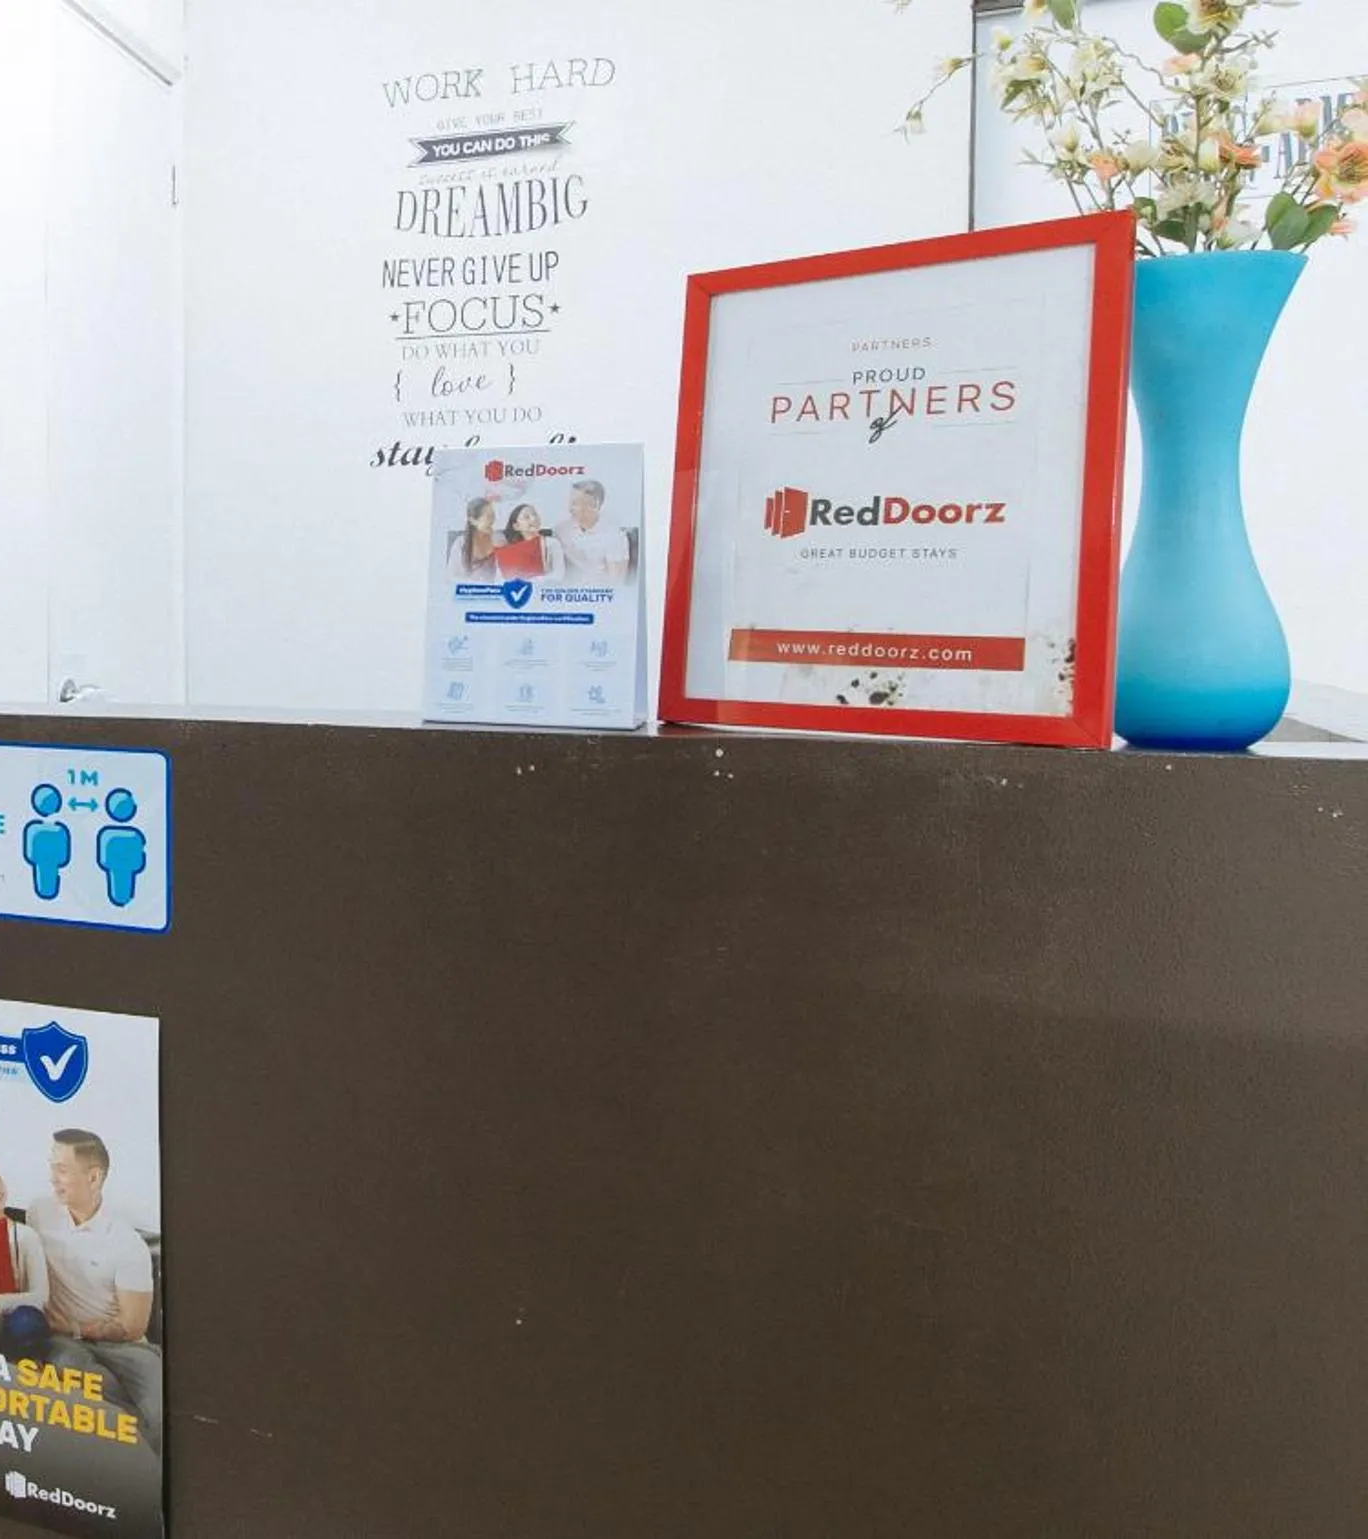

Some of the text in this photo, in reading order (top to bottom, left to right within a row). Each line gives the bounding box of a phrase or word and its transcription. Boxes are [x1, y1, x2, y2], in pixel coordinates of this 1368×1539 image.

[382, 57, 617, 108] WORK HARD
[432, 143, 460, 158] YOU
[463, 140, 493, 154] CAN
[495, 136, 516, 150] DO
[382, 250, 560, 288] NEVER GIVE UP
[402, 293, 545, 334] FOCUS
[402, 338, 541, 361] DO WHAT YOU
[851, 337, 932, 352] PARTNERS
[431, 366, 494, 398] love
[852, 367, 926, 385] PROUD
[771, 381, 1017, 424] PARTNERS
[403, 406, 543, 428] WHAT YOU DO
[504, 464, 586, 478] RedDoorz
[809, 495, 1007, 527] RedDoorz
[800, 547, 958, 560] GREAT BUDGET STAYS
[540, 593, 615, 603] FOR QUALITY
[776, 641, 974, 663] www.reddoorz.com
[67, 769, 99, 787] 1 M
[16, 1358, 104, 1403] SAFE
[26, 1481, 117, 1520] RedDoorz
